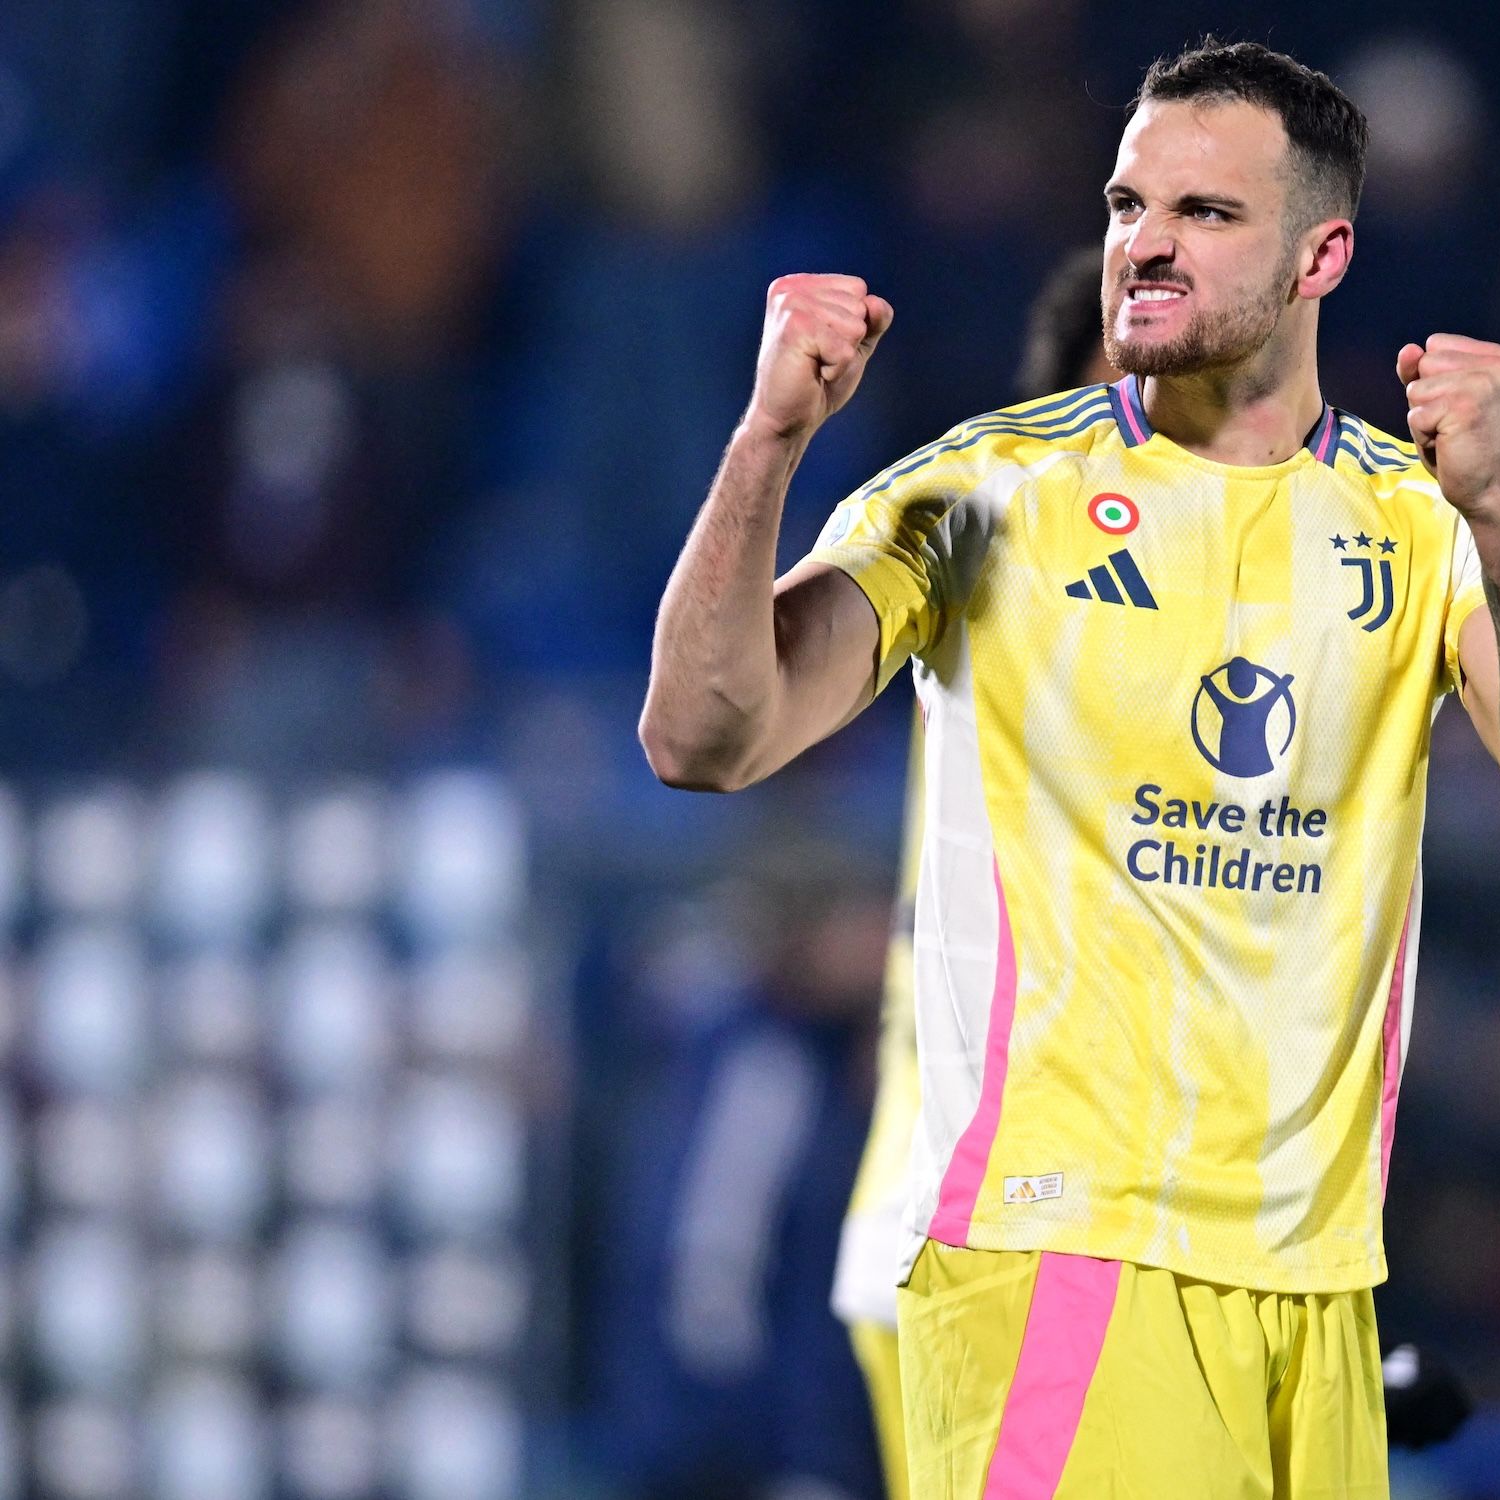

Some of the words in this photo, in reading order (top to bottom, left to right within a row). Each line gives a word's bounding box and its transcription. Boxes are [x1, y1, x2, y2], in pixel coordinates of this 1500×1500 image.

[1131, 784, 1246, 833] Save
[1259, 796, 1327, 838] the
[1127, 839, 1322, 894] Children
